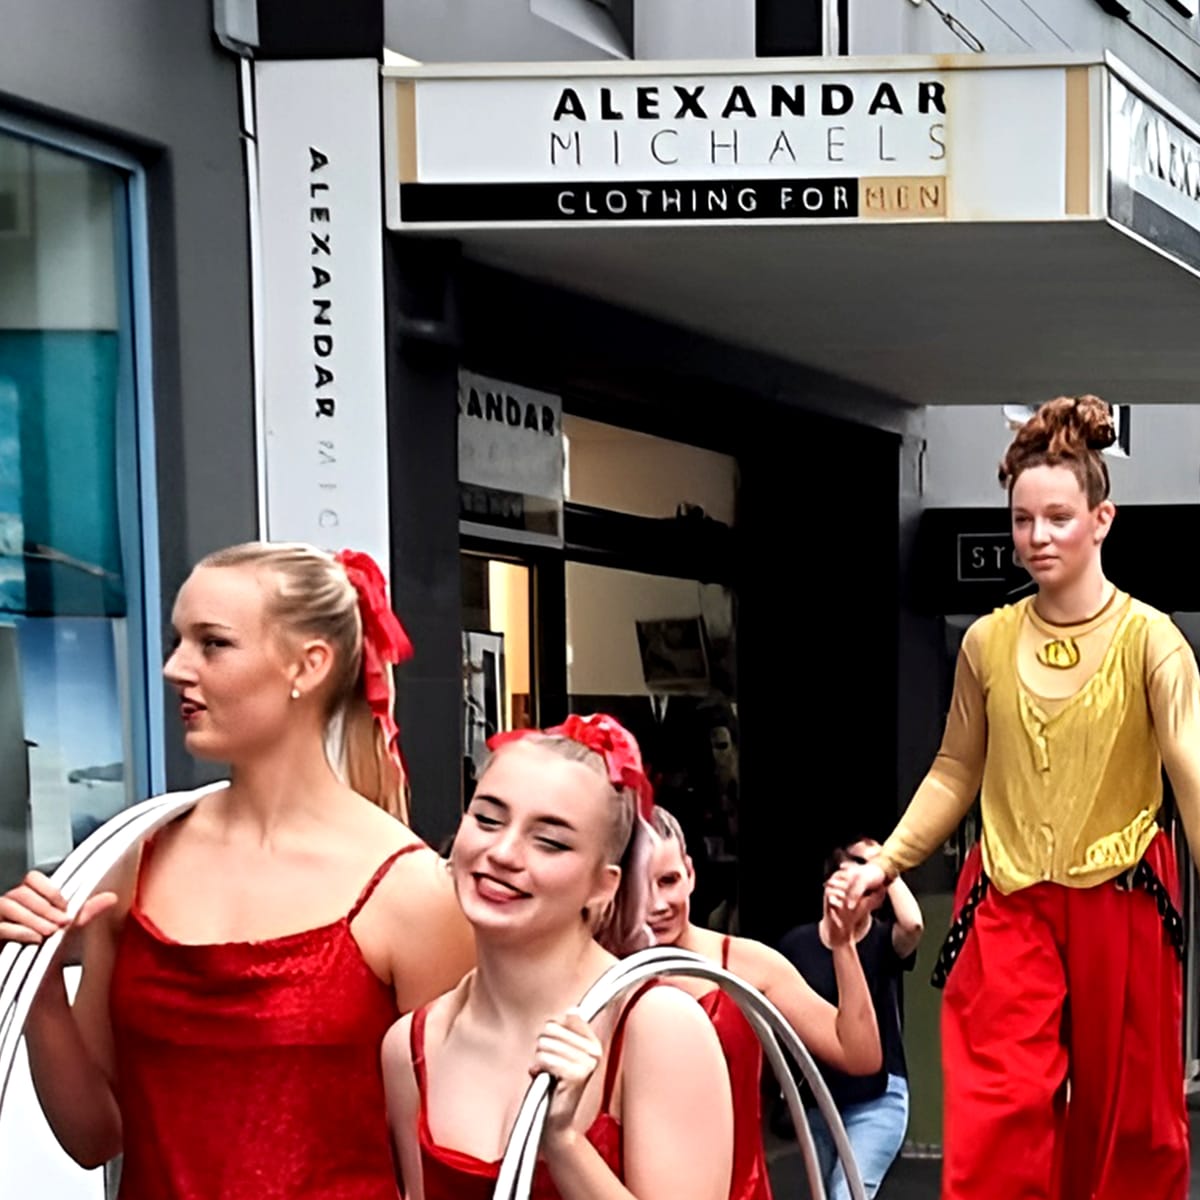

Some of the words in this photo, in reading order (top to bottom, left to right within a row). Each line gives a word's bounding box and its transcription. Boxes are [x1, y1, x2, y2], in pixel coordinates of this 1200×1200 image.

[552, 81, 947, 122] ALEXANDAR
[550, 123, 947, 166] MICHAELS
[557, 186, 758, 214] CLOTHING
[780, 185, 849, 211] FOR
[865, 185, 940, 210] MEN
[308, 146, 336, 419] ALEXANDAR
